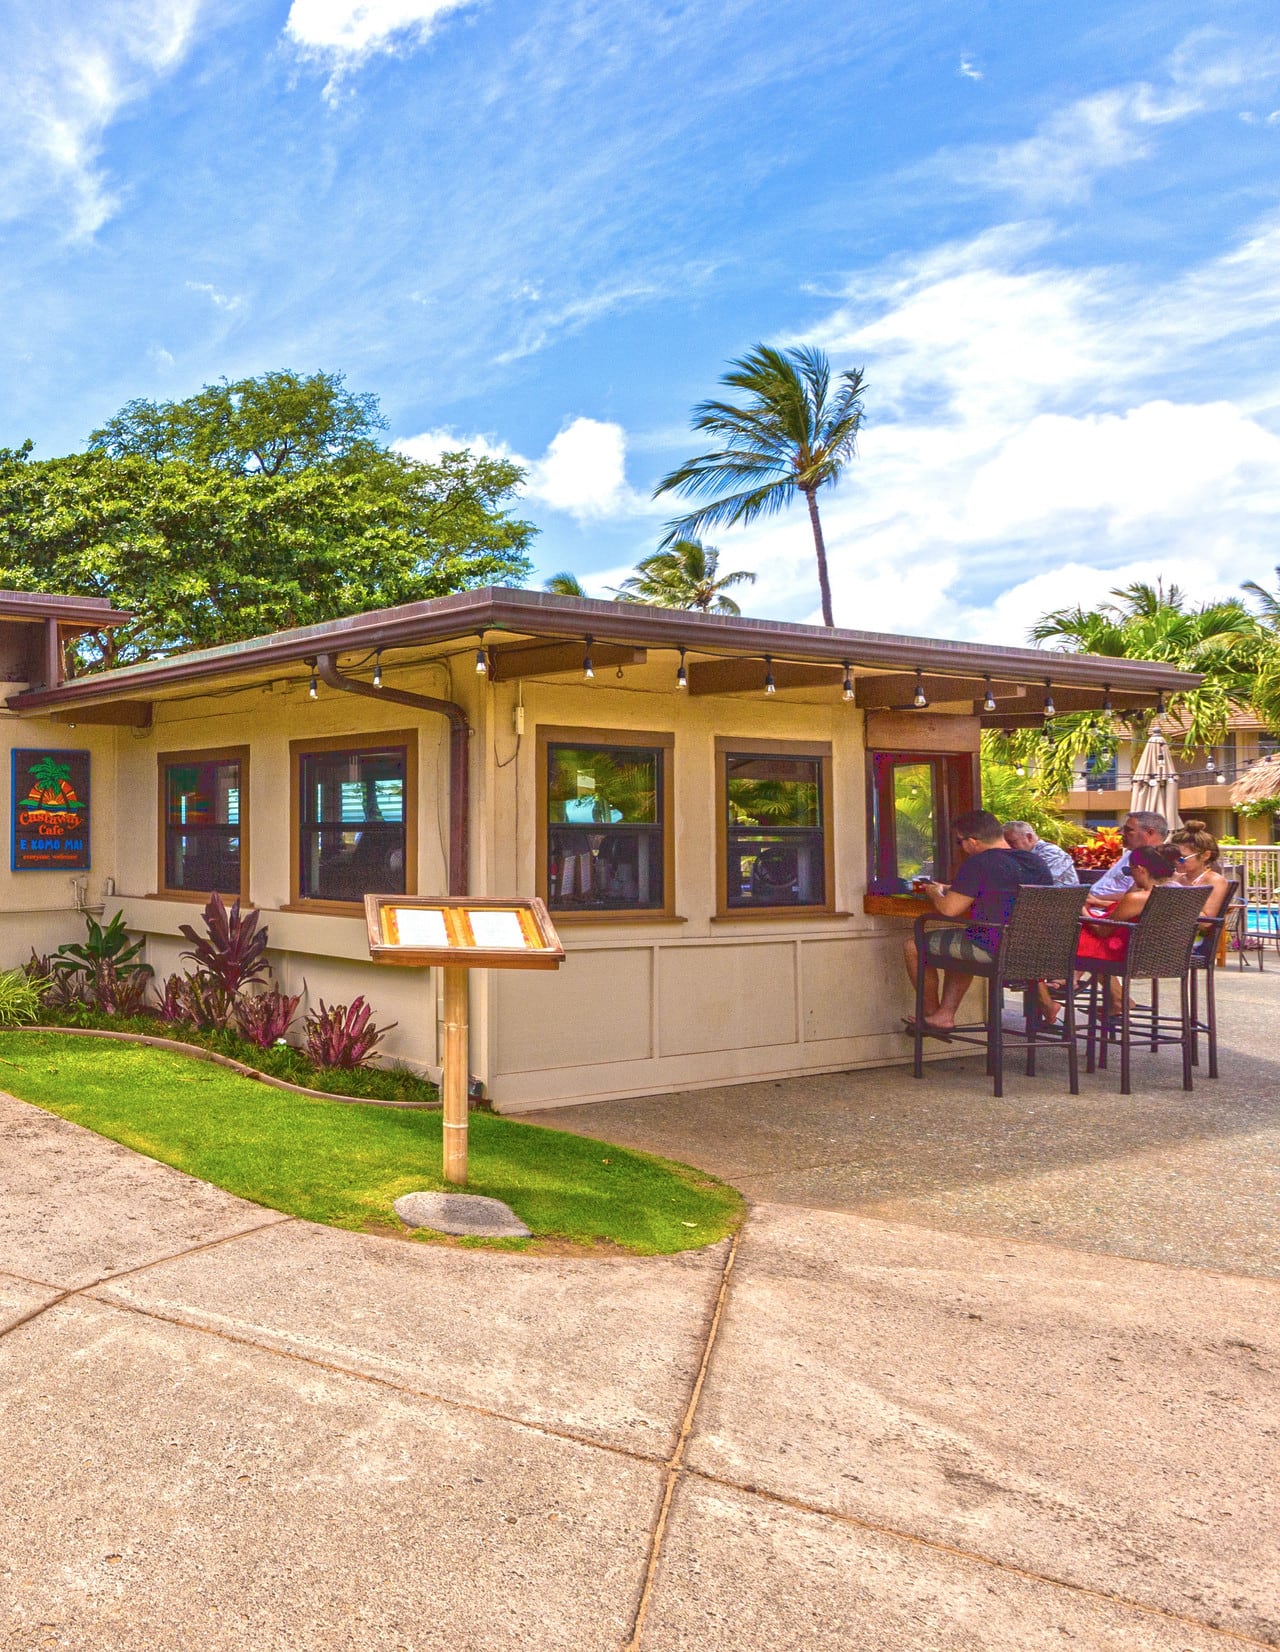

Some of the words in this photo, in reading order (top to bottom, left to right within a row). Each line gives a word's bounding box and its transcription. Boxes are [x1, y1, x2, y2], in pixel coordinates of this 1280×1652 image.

[19, 811, 81, 830] Castaway
[39, 824, 64, 835] Cafe
[20, 839, 27, 850] E
